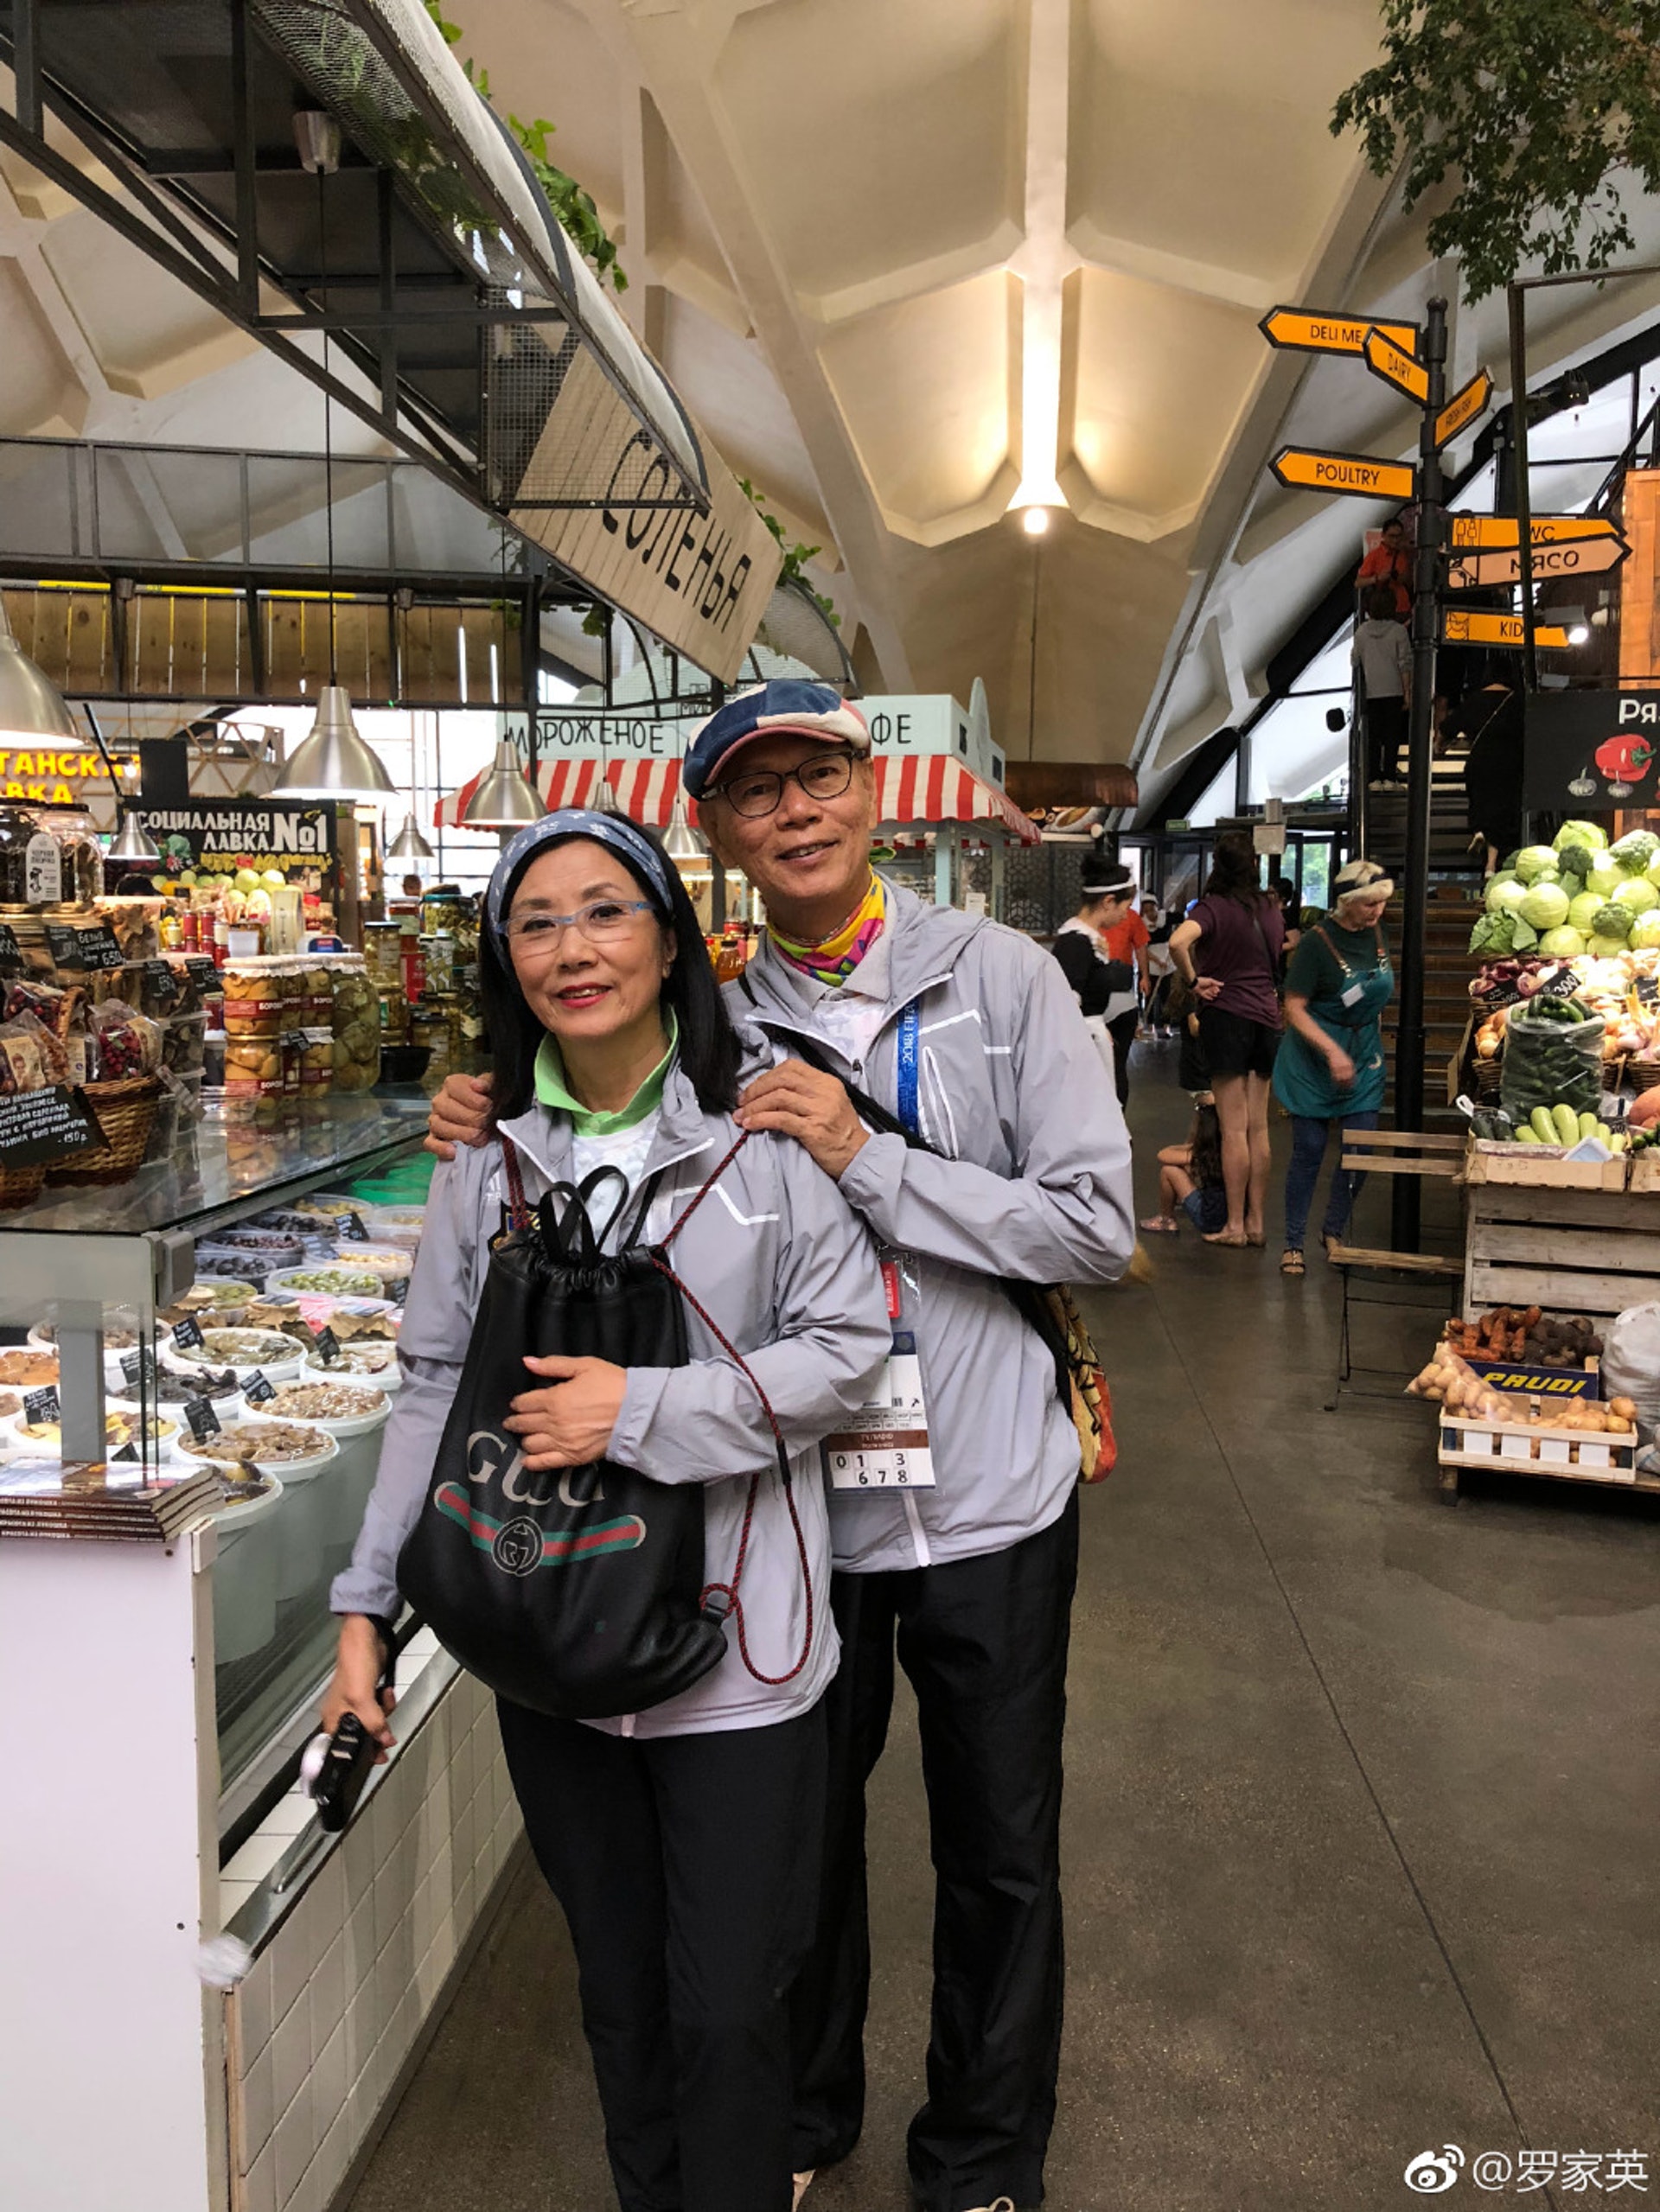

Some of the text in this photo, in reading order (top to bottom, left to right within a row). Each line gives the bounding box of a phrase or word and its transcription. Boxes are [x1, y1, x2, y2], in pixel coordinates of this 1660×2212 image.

[1310, 325, 1363, 344] DELI ME
[1315, 462, 1381, 486] POULTRY
[1499, 622, 1524, 637] KID
[1618, 698, 1660, 724] Ря
[871, 712, 911, 745] ФЕ
[0, 781, 73, 804] ВКА
[138, 811, 271, 832] СОЦИАЛЬНАЯ
[203, 832, 270, 851] ЛАВКА
[902, 1033, 914, 1064] 2018
[836, 1455, 847, 1469] 0
[895, 1452, 906, 1465] 3
[859, 1472, 869, 1485] 6
[897, 1469, 908, 1483] 8
